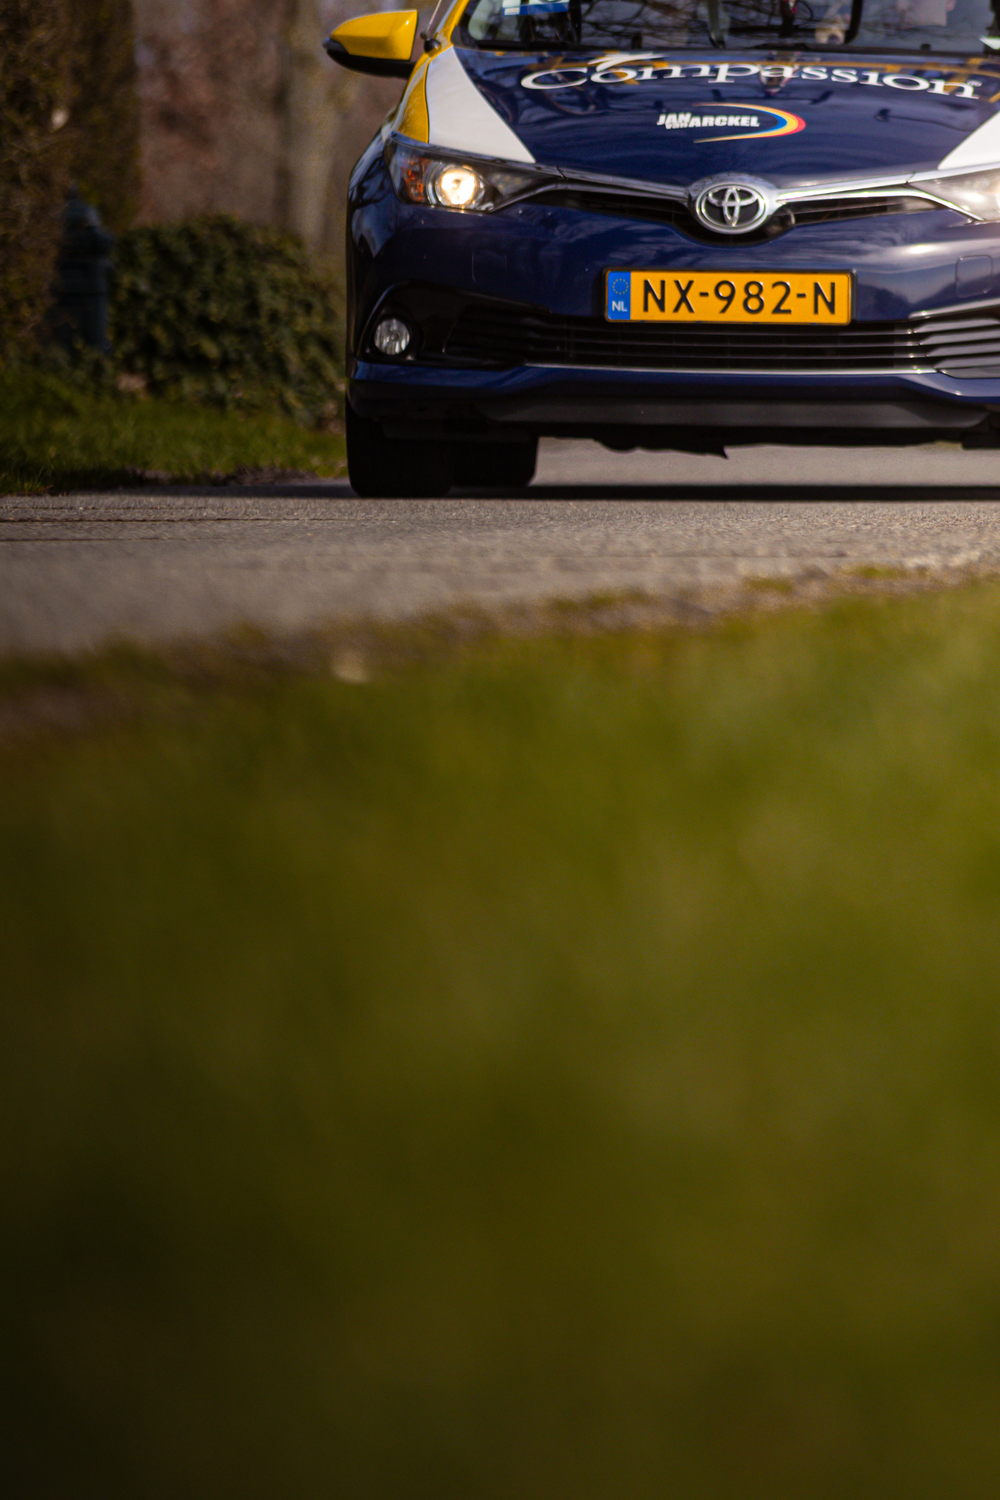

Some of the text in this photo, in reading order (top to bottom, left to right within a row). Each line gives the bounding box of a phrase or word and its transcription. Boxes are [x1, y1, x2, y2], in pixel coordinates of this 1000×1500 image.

[656, 112, 691, 126] JAN
[688, 115, 760, 128] ARCKEL
[611, 279, 836, 315] NL NX-982-N
